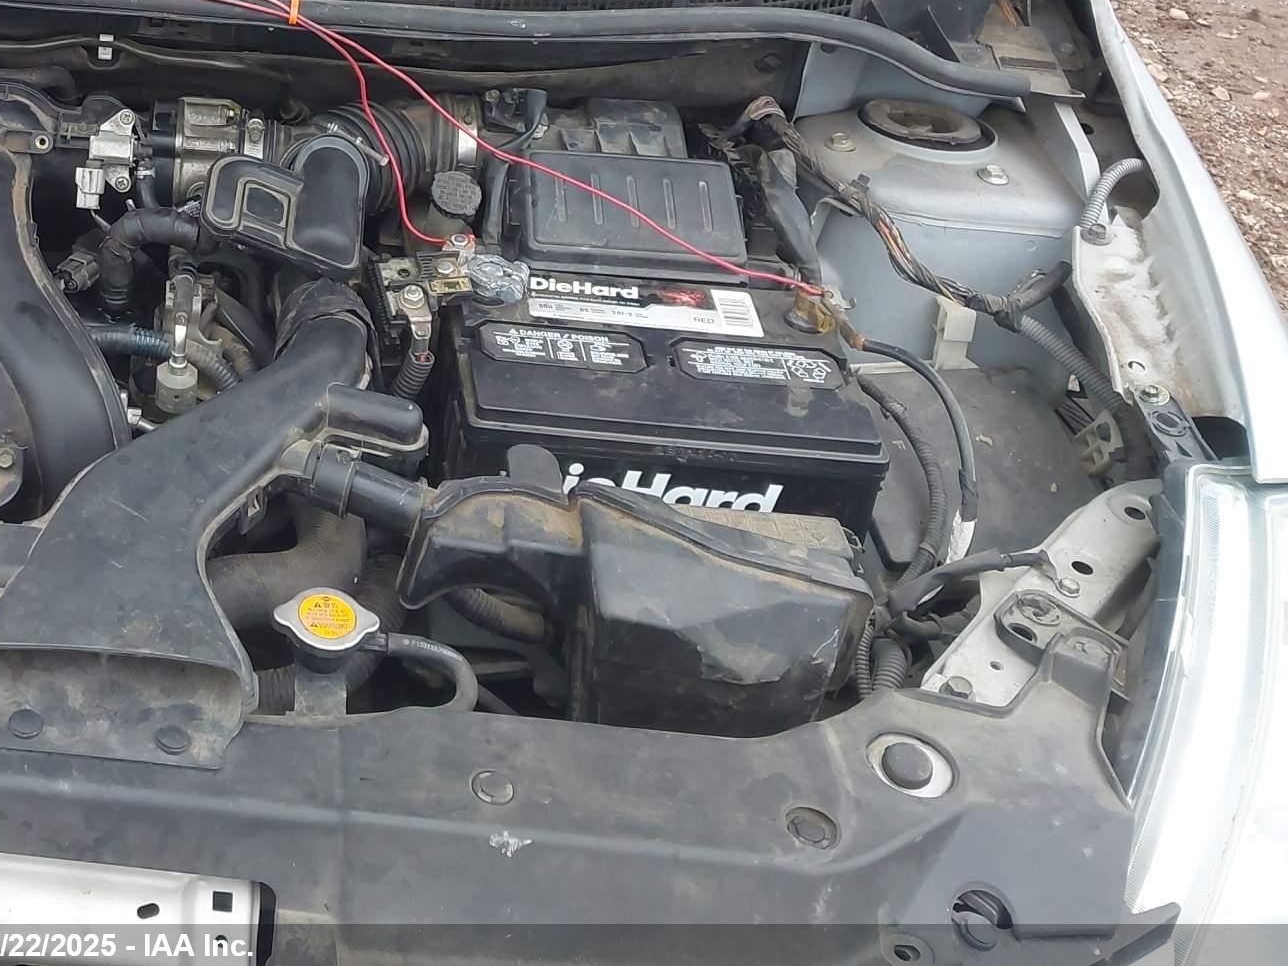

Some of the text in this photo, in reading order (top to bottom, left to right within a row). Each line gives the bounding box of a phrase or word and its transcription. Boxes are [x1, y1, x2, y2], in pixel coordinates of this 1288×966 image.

[529, 276, 640, 300] DieHard
[519, 328, 562, 340] DANGER
[570, 333, 609, 343] POISON
